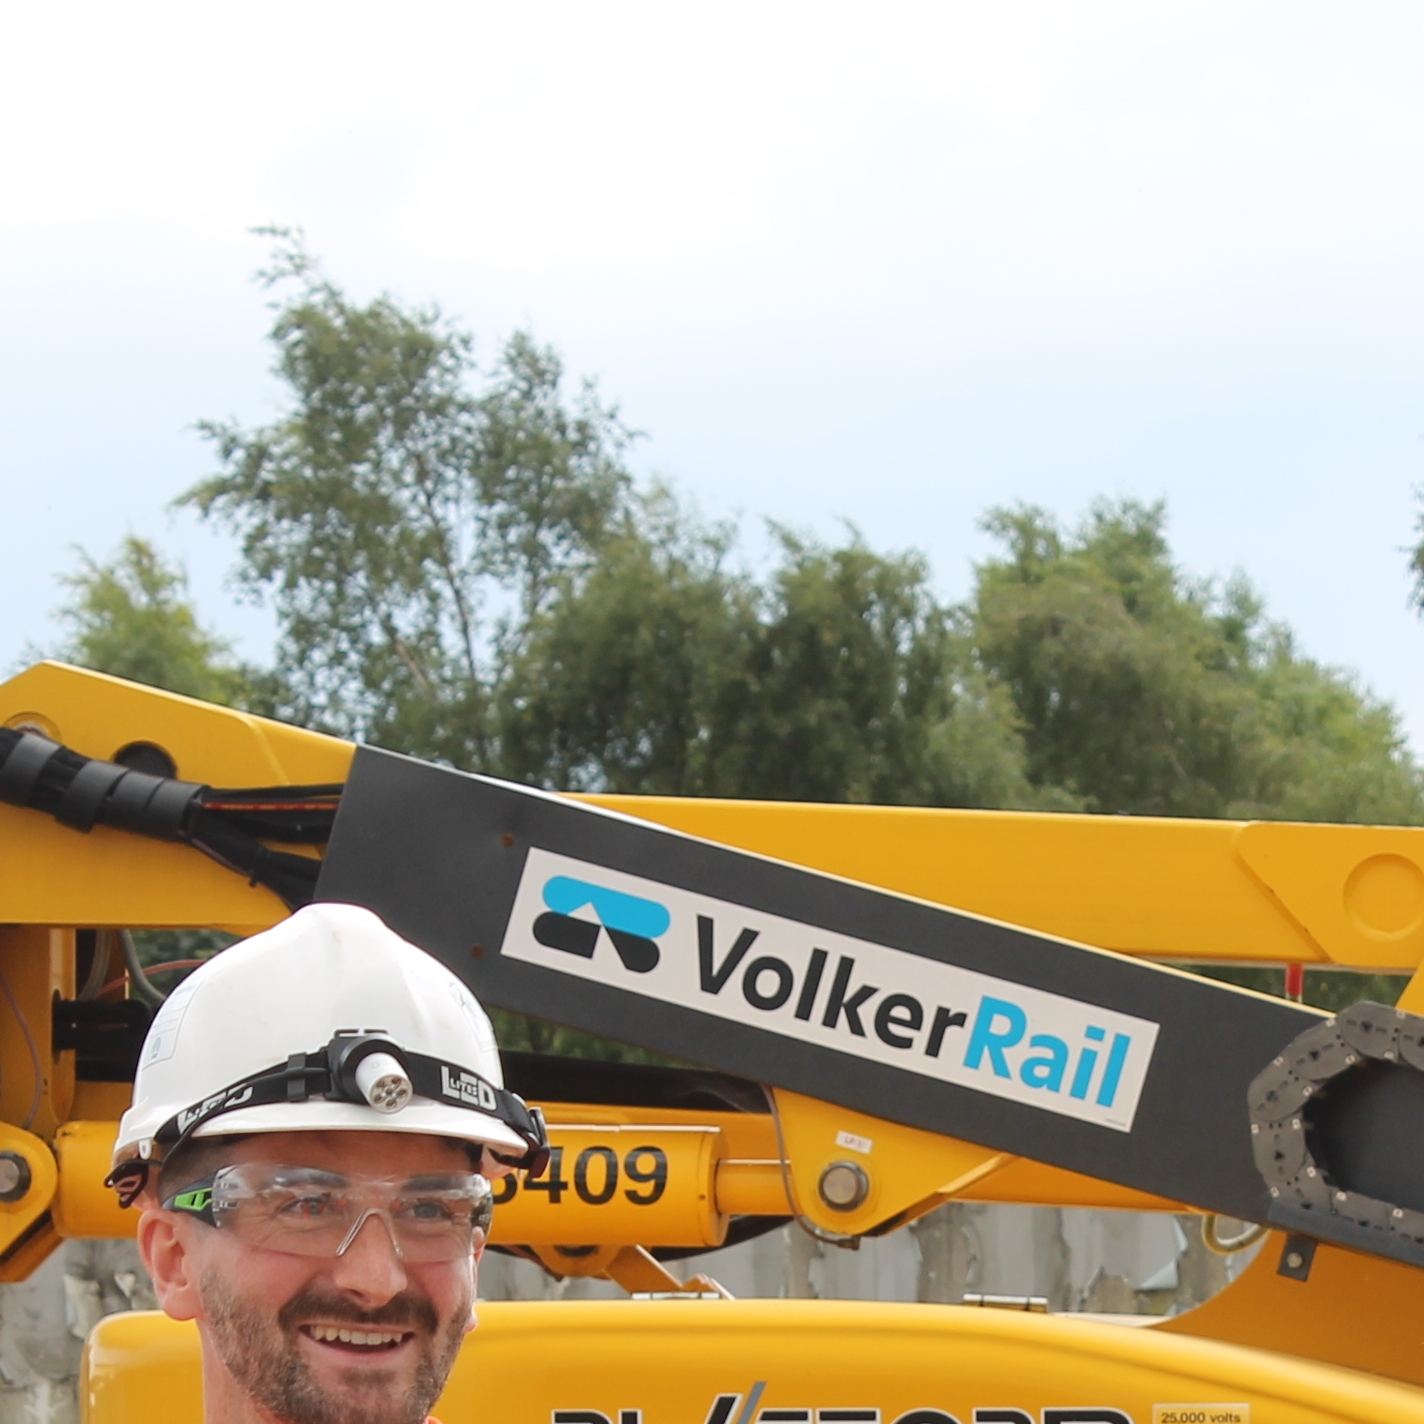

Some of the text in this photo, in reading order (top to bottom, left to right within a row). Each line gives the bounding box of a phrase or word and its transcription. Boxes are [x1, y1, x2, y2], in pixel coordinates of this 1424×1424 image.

[695, 914, 1131, 1108] VolkerRail
[441, 1065, 497, 1111] LED
[1161, 1412, 1241, 1424] 25,000 volts
